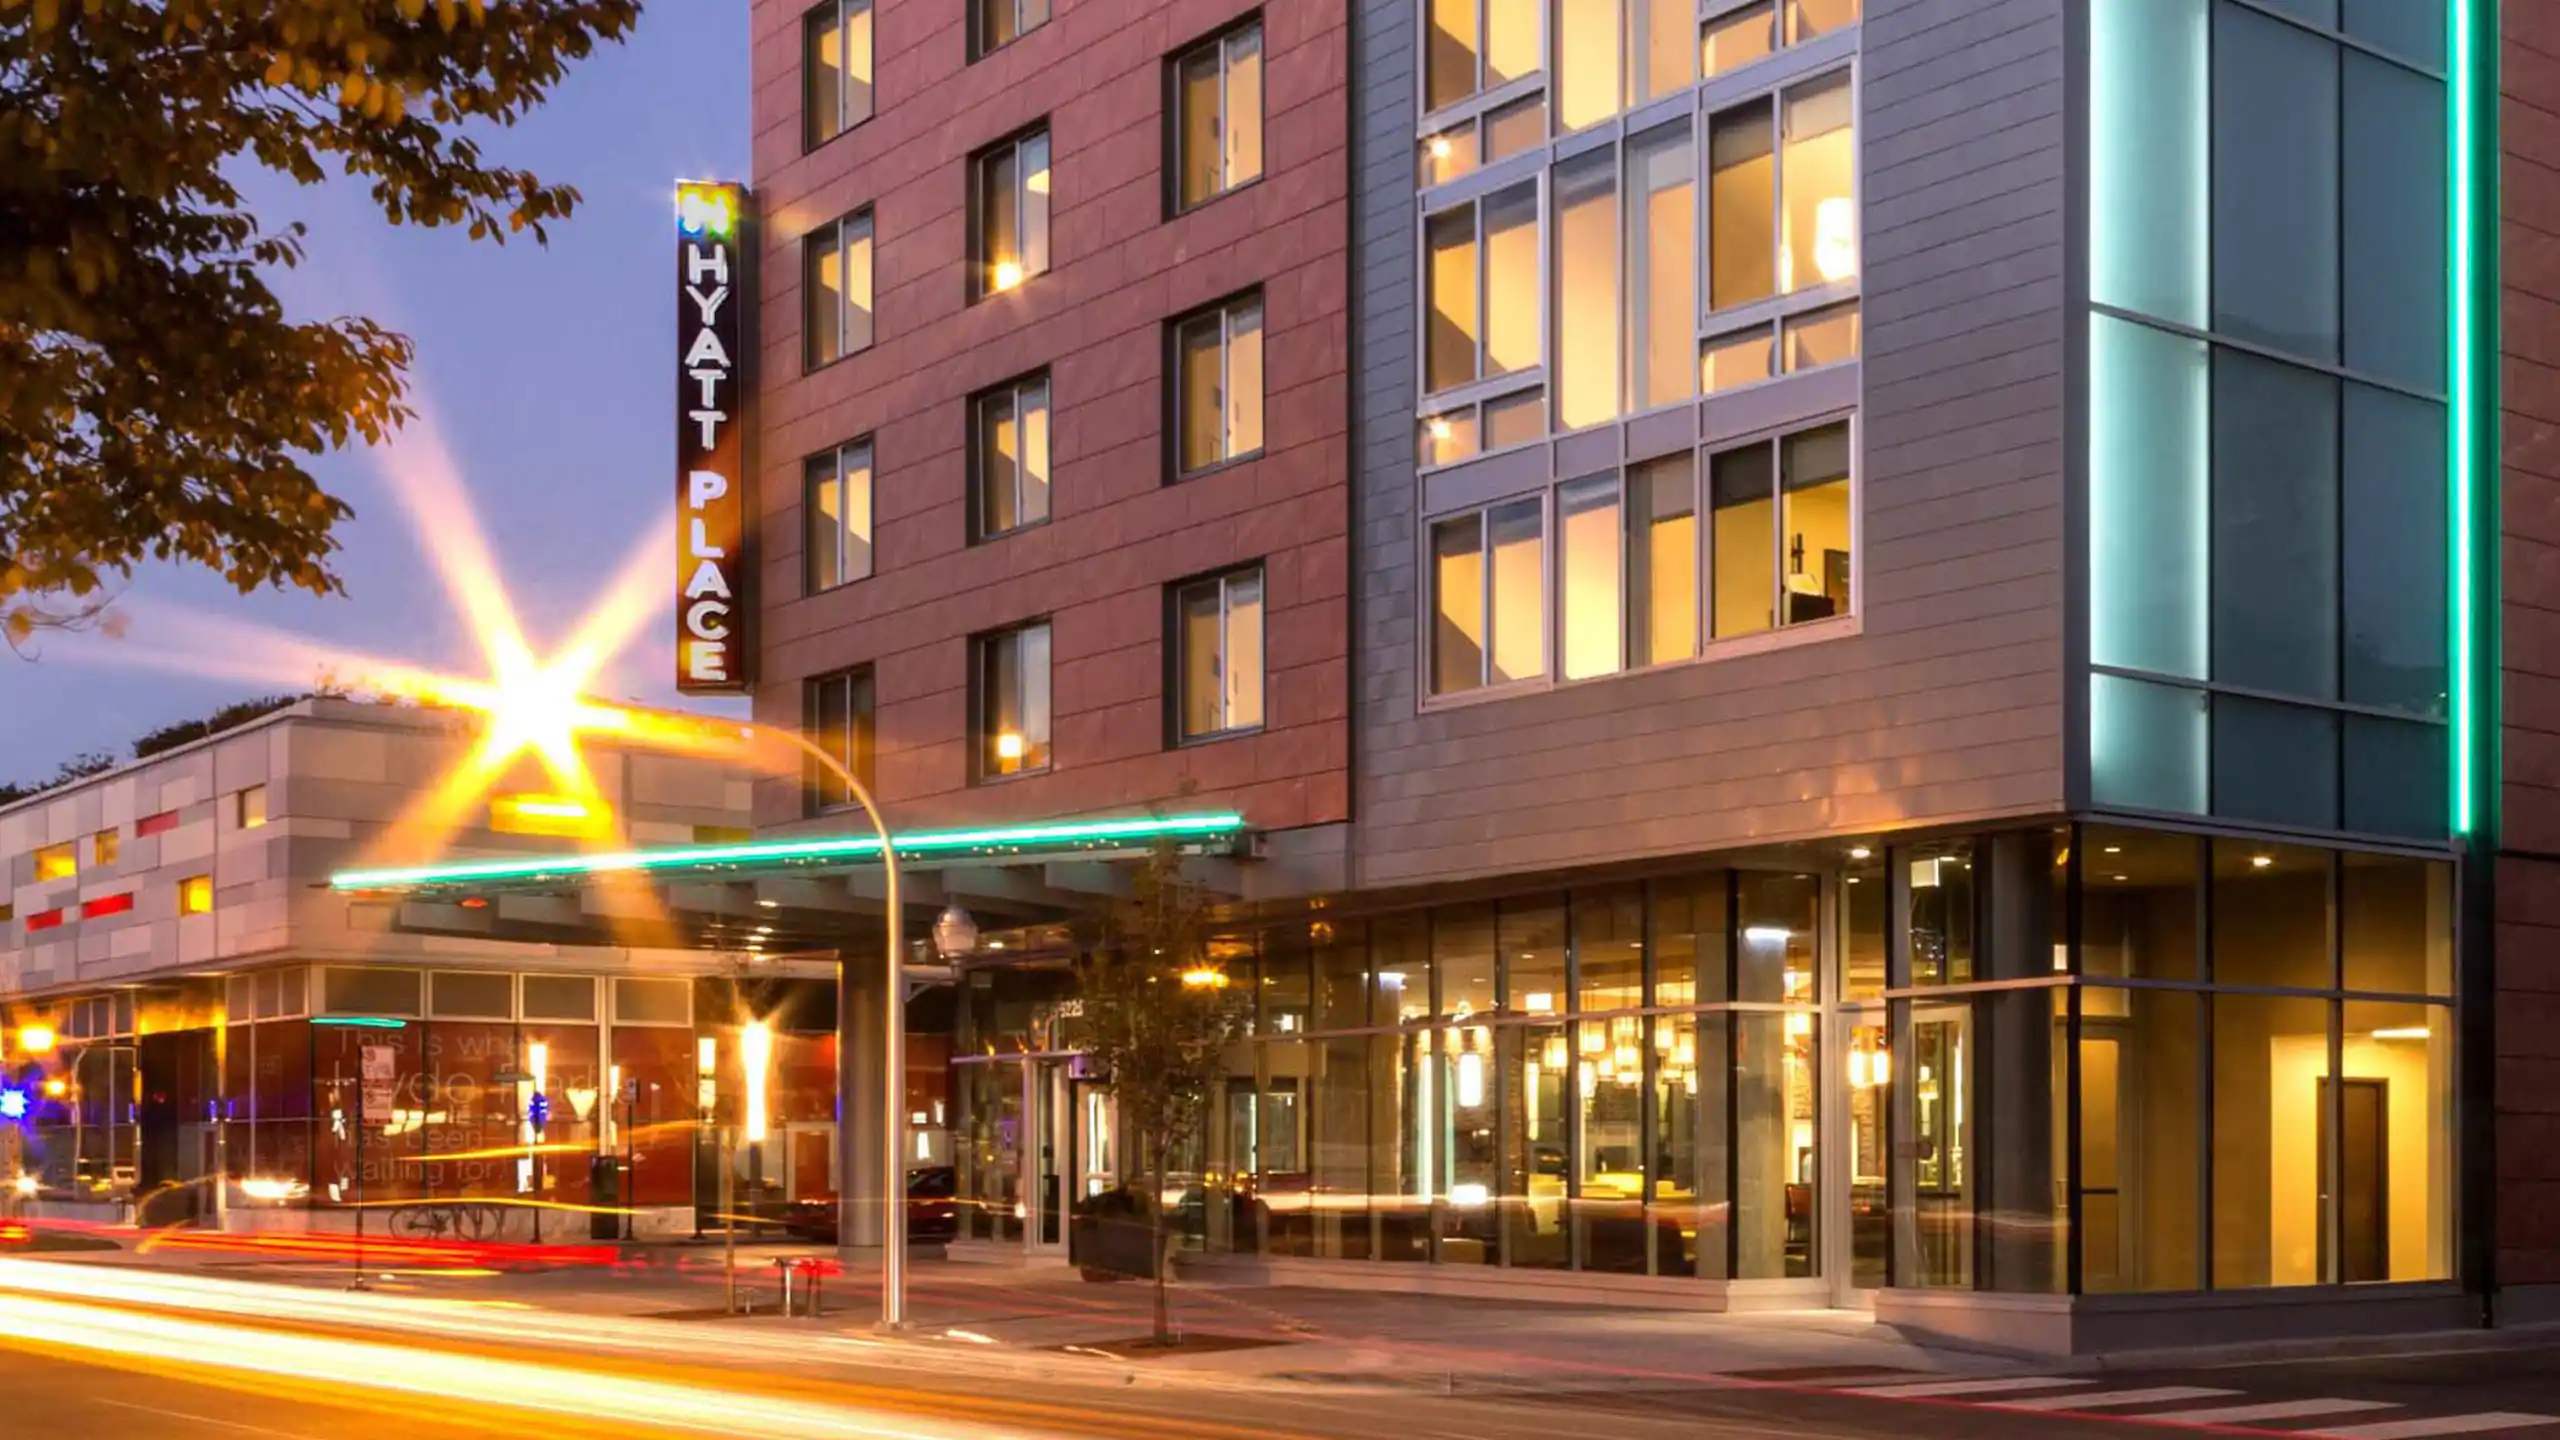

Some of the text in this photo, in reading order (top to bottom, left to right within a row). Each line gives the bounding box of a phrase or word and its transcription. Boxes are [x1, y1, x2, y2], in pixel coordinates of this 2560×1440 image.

[684, 243, 732, 682] HYATT PLACE
[333, 1027, 407, 1055] This
